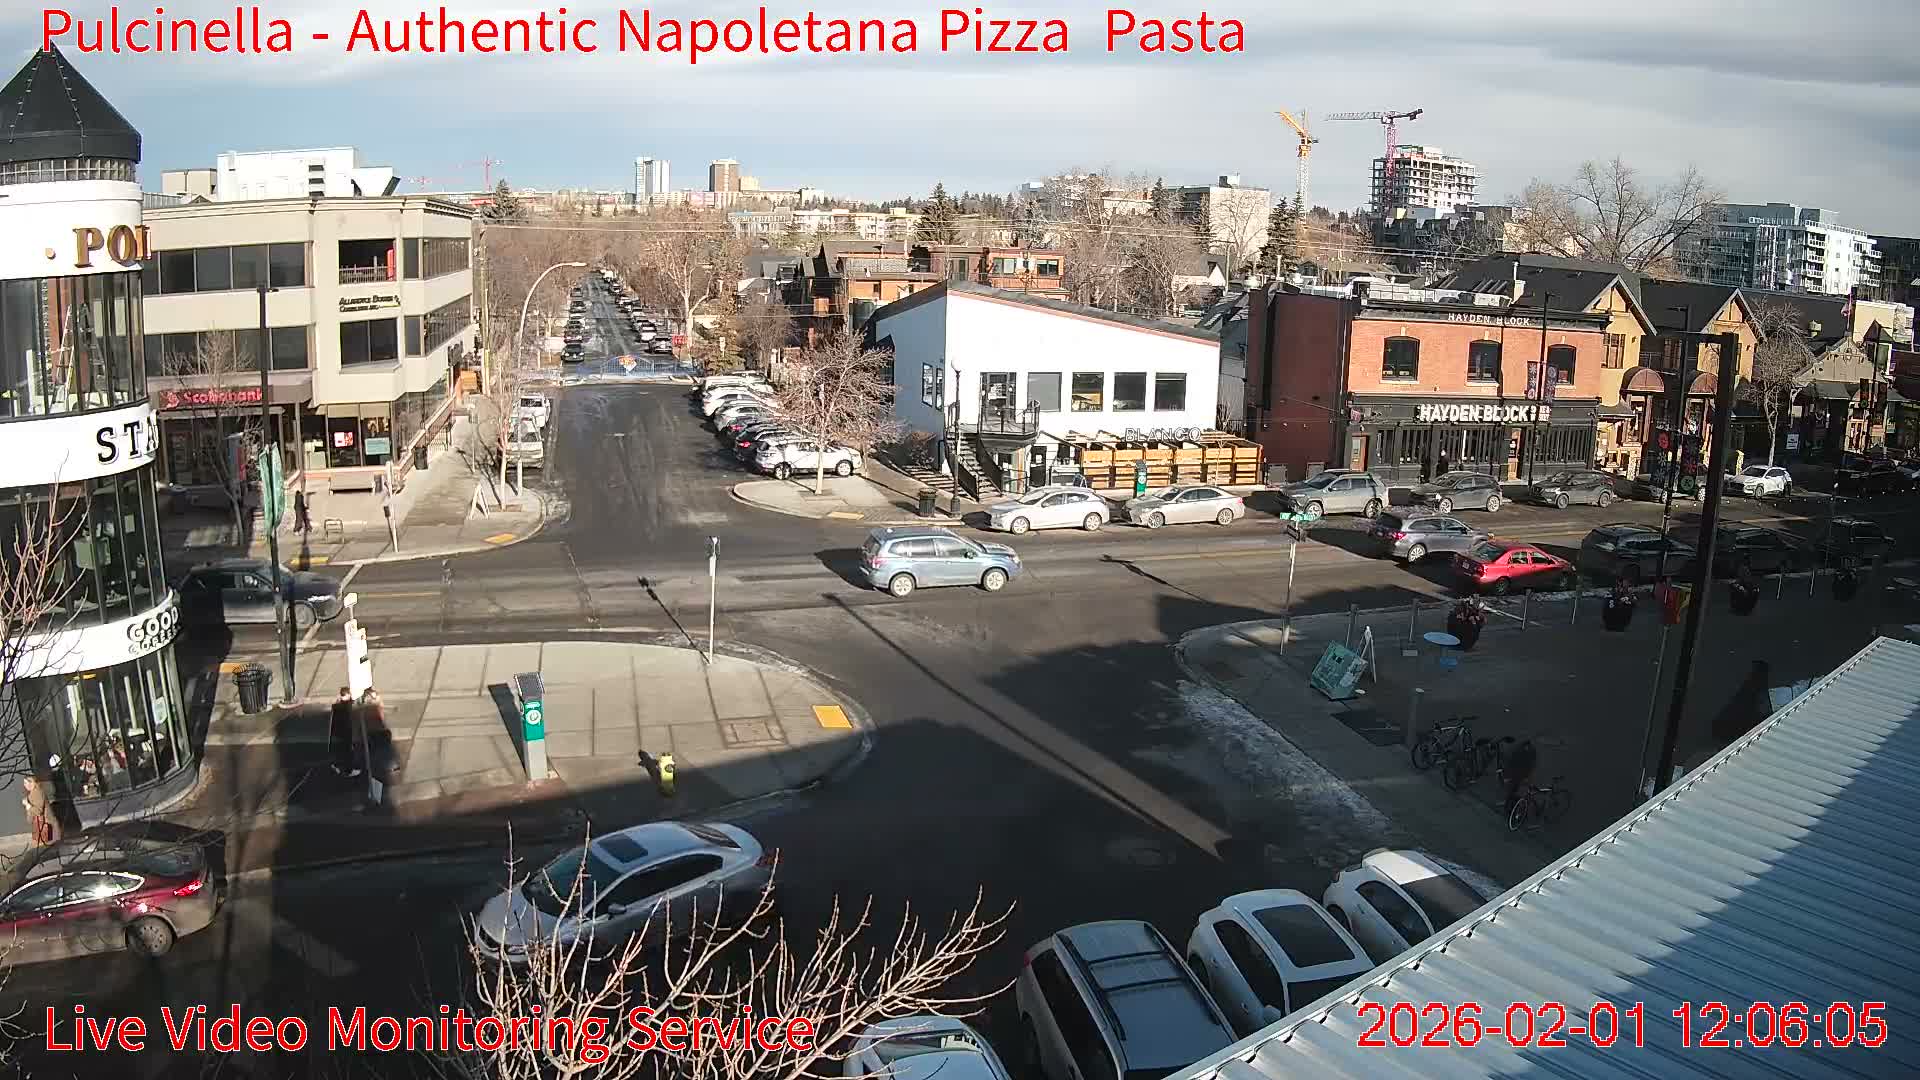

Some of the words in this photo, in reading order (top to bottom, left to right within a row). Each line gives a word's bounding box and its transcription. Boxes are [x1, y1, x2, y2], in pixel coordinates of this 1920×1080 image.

[1448, 312, 1490, 324] HAYDEN
[1496, 316, 1530, 326] BLOCK
[1418, 403, 1480, 423] HAYDEN
[1125, 427, 1201, 442] BLANCO
[127, 605, 179, 642] GOOD
